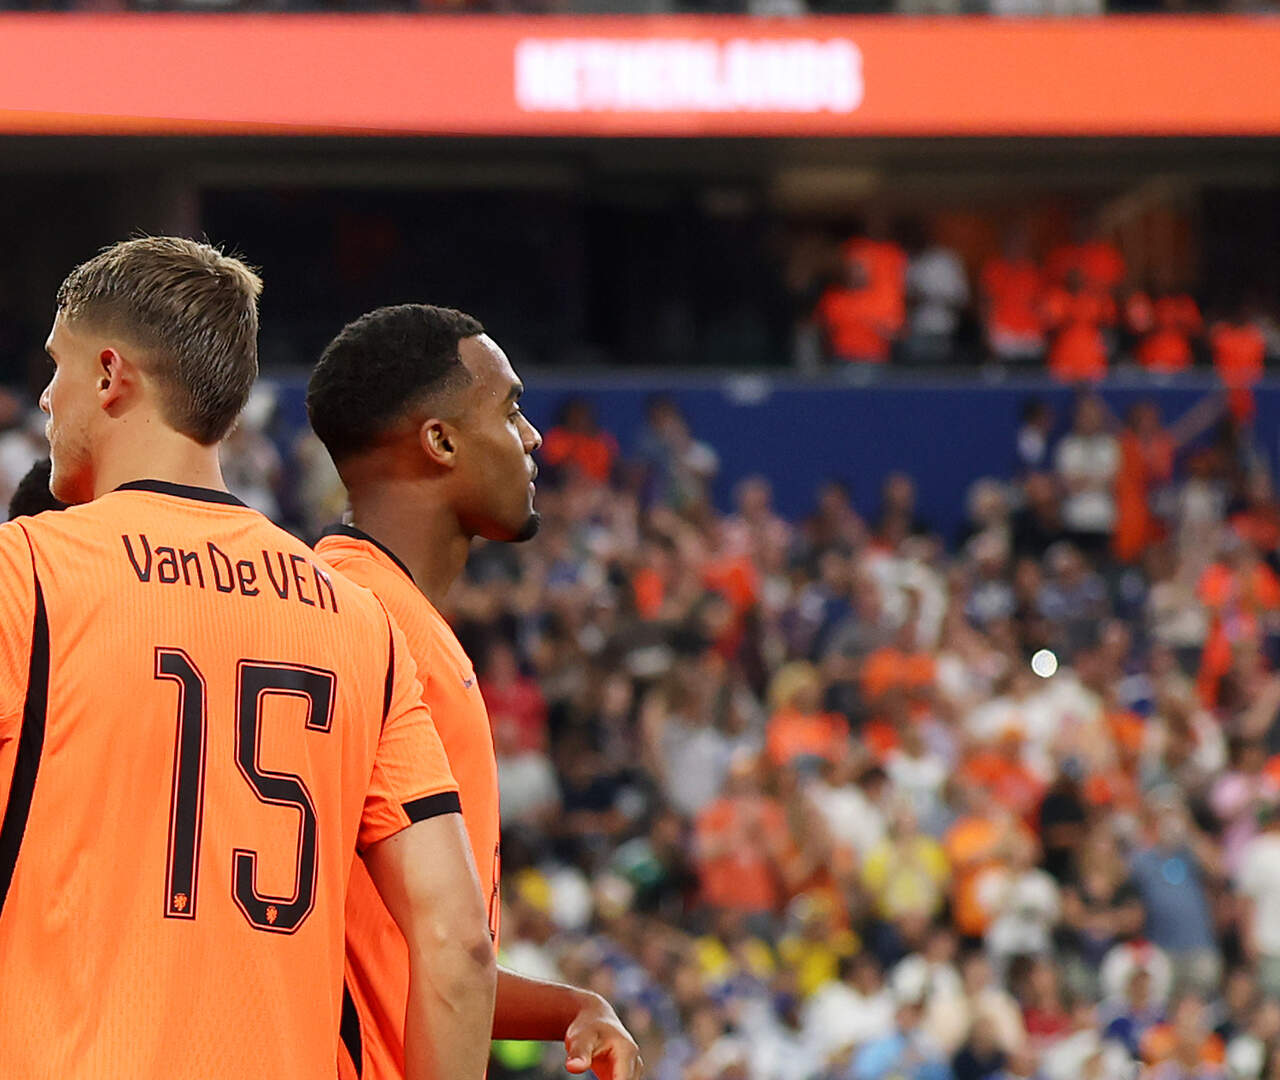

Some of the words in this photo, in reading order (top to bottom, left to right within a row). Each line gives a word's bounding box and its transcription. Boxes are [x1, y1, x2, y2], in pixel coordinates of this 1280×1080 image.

[121, 534, 205, 589] Van
[206, 541, 261, 597] De
[153, 646, 338, 935] 15
